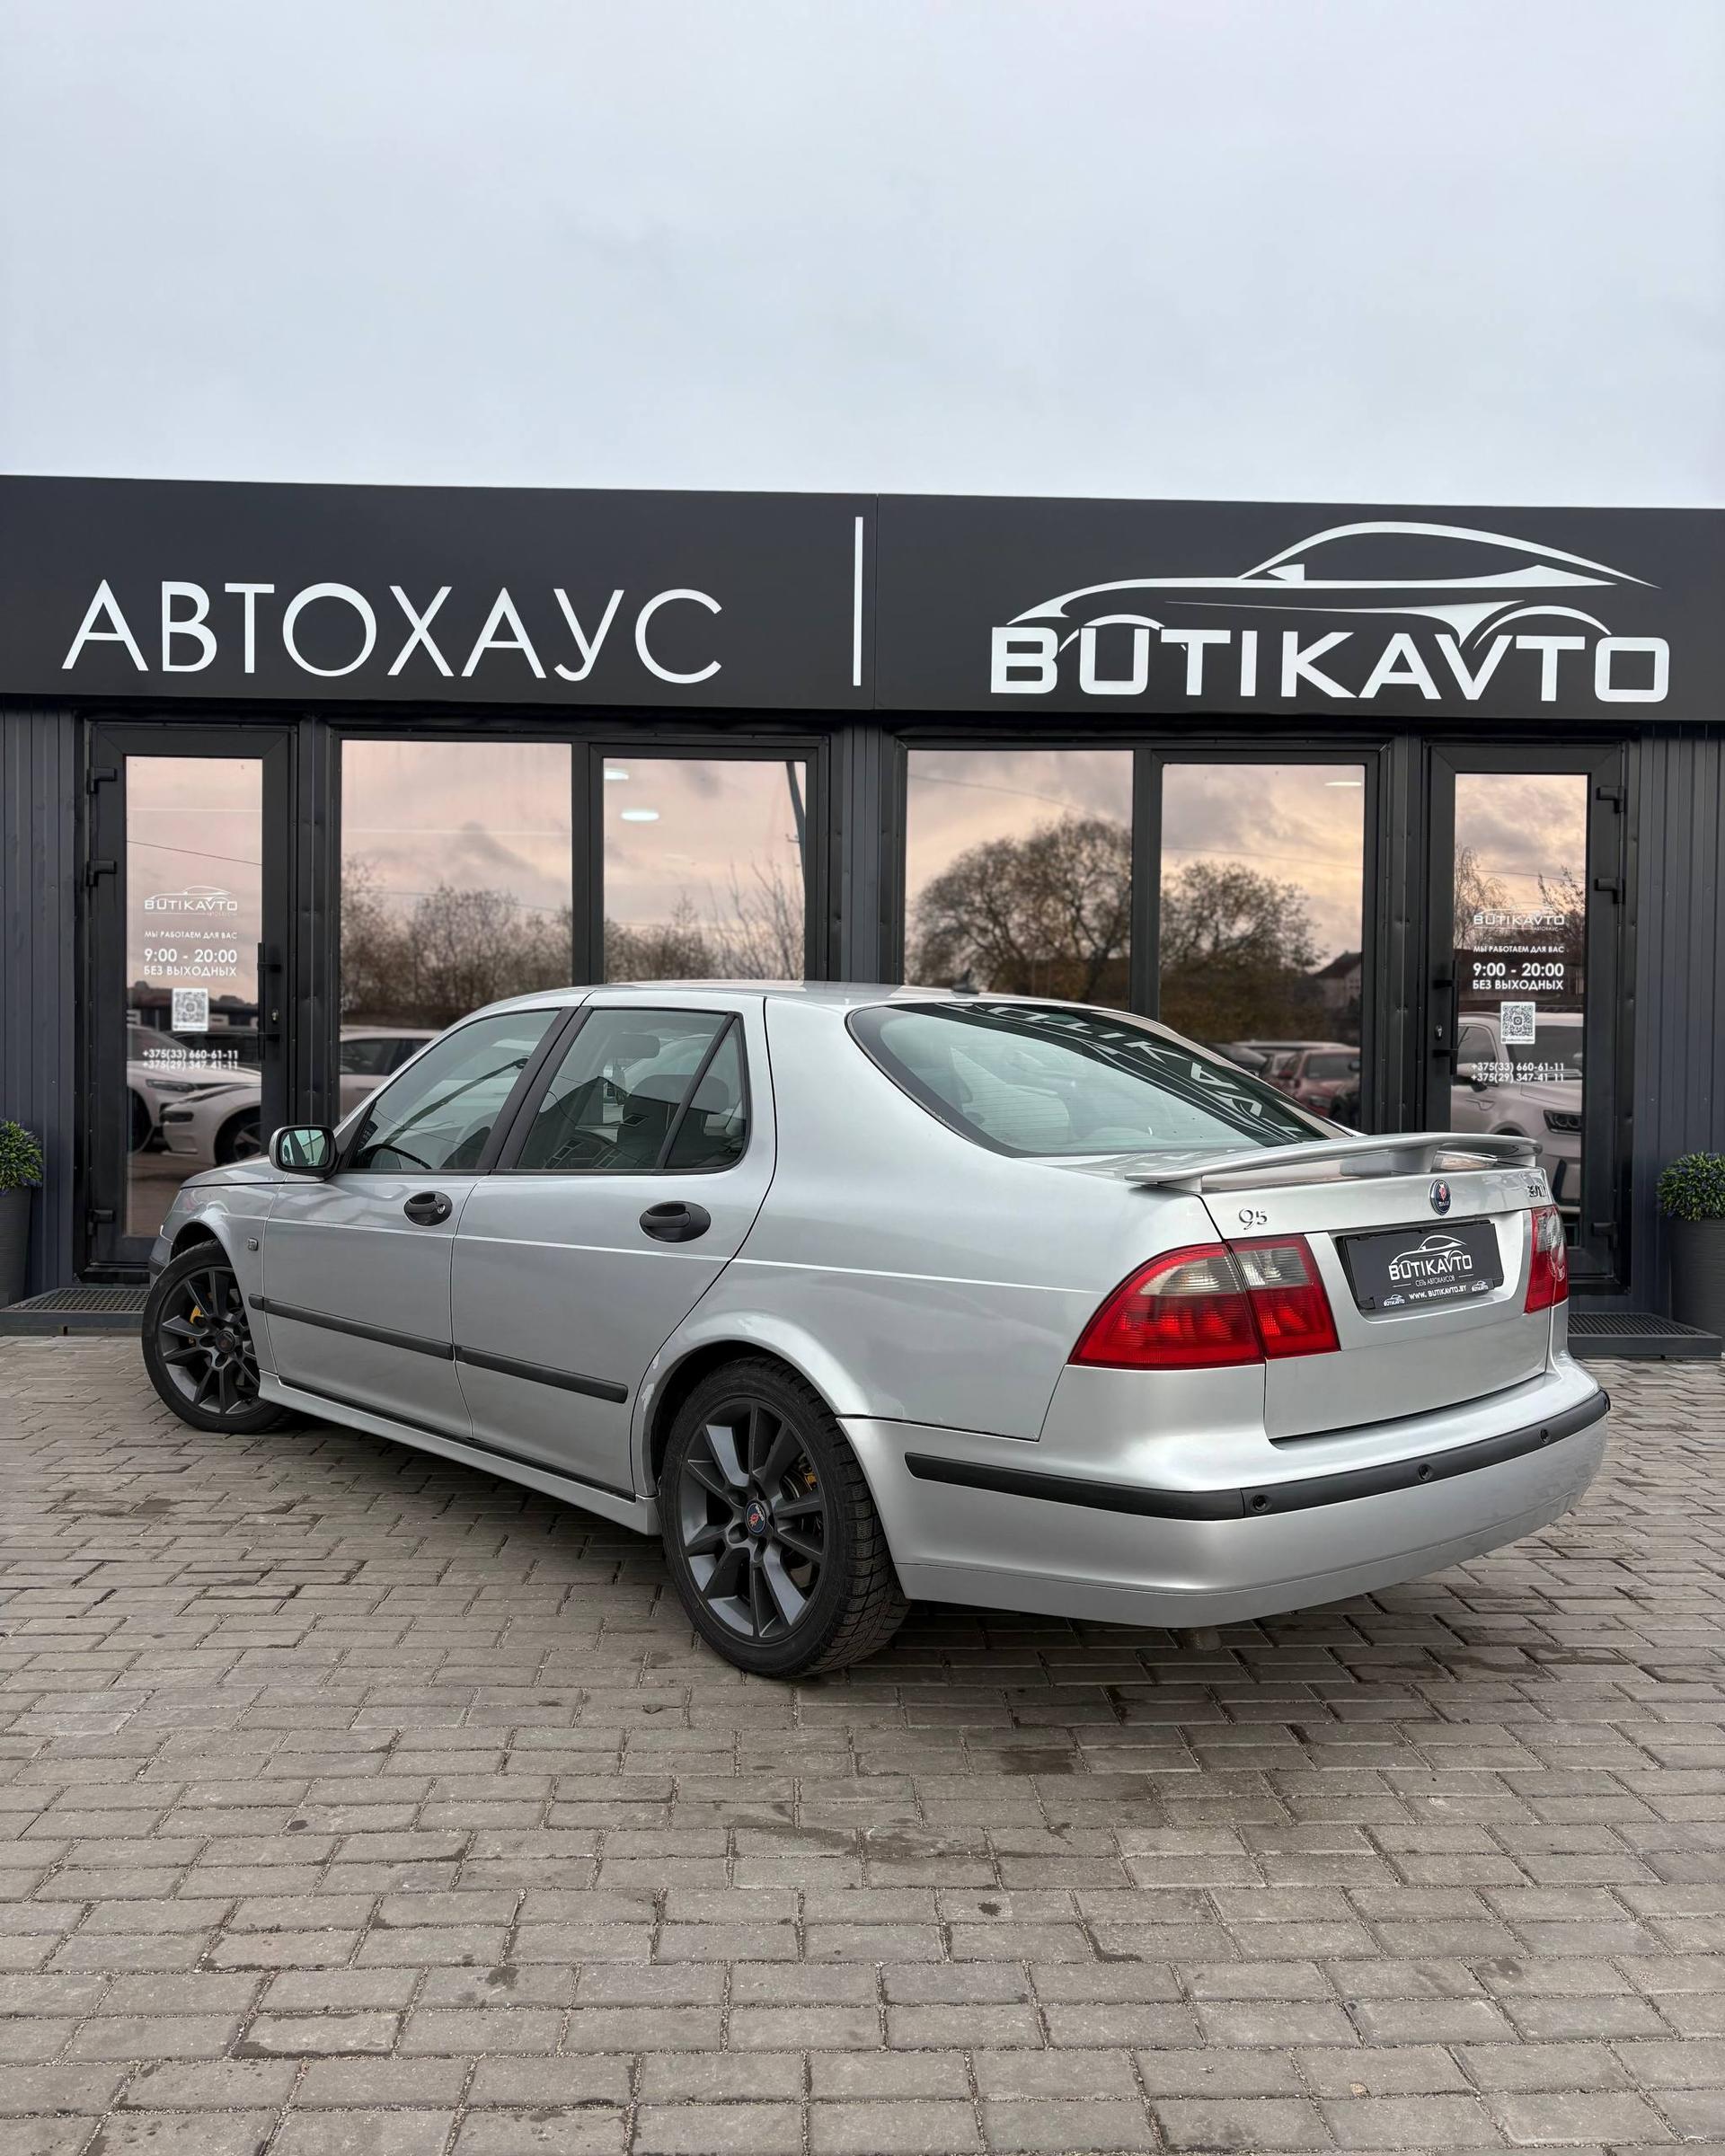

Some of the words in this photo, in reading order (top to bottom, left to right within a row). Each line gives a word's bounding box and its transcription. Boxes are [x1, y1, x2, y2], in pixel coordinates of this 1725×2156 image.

[62, 579, 722, 684] АВТОХАУС
[991, 626, 1669, 702] BUTIKAVTO
[145, 898, 238, 911] BUTIKAVTO
[1473, 915, 1565, 925] BUTIKAVTO
[160, 931, 201, 939] РАБОТАЕМ
[203, 932, 218, 940] ДЛЯ
[1530, 946, 1546, 954] ДЛЯ
[145, 949, 178, 962] 9:00
[194, 949, 237, 963] 20:00
[144, 966, 163, 976] БЕЗ
[166, 966, 237, 977] ВЫХОДНЫХ
[1473, 962, 1506, 976] 9:00
[1521, 962, 1564, 976] 20:00
[1473, 979, 1491, 990] БЕЗ
[1495, 979, 1564, 991] ВЫХОДНЫХ
[143, 1049, 187, 1060] +375(33)
[189, 1049, 238, 1059] 660-61-11
[189, 1061, 238, 1070] 34741-11
[1471, 1062, 1514, 1073] +375(33)
[1516, 1062, 1564, 1071] 660-61-11
[1471, 1073, 1514, 1083] +375(29)
[1516, 1073, 1564, 1082] 347-4111
[1388, 1254, 1473, 1281] BUTIKAVTO
[1428, 1285, 1467, 1298] BUTIKAVTO.BY
